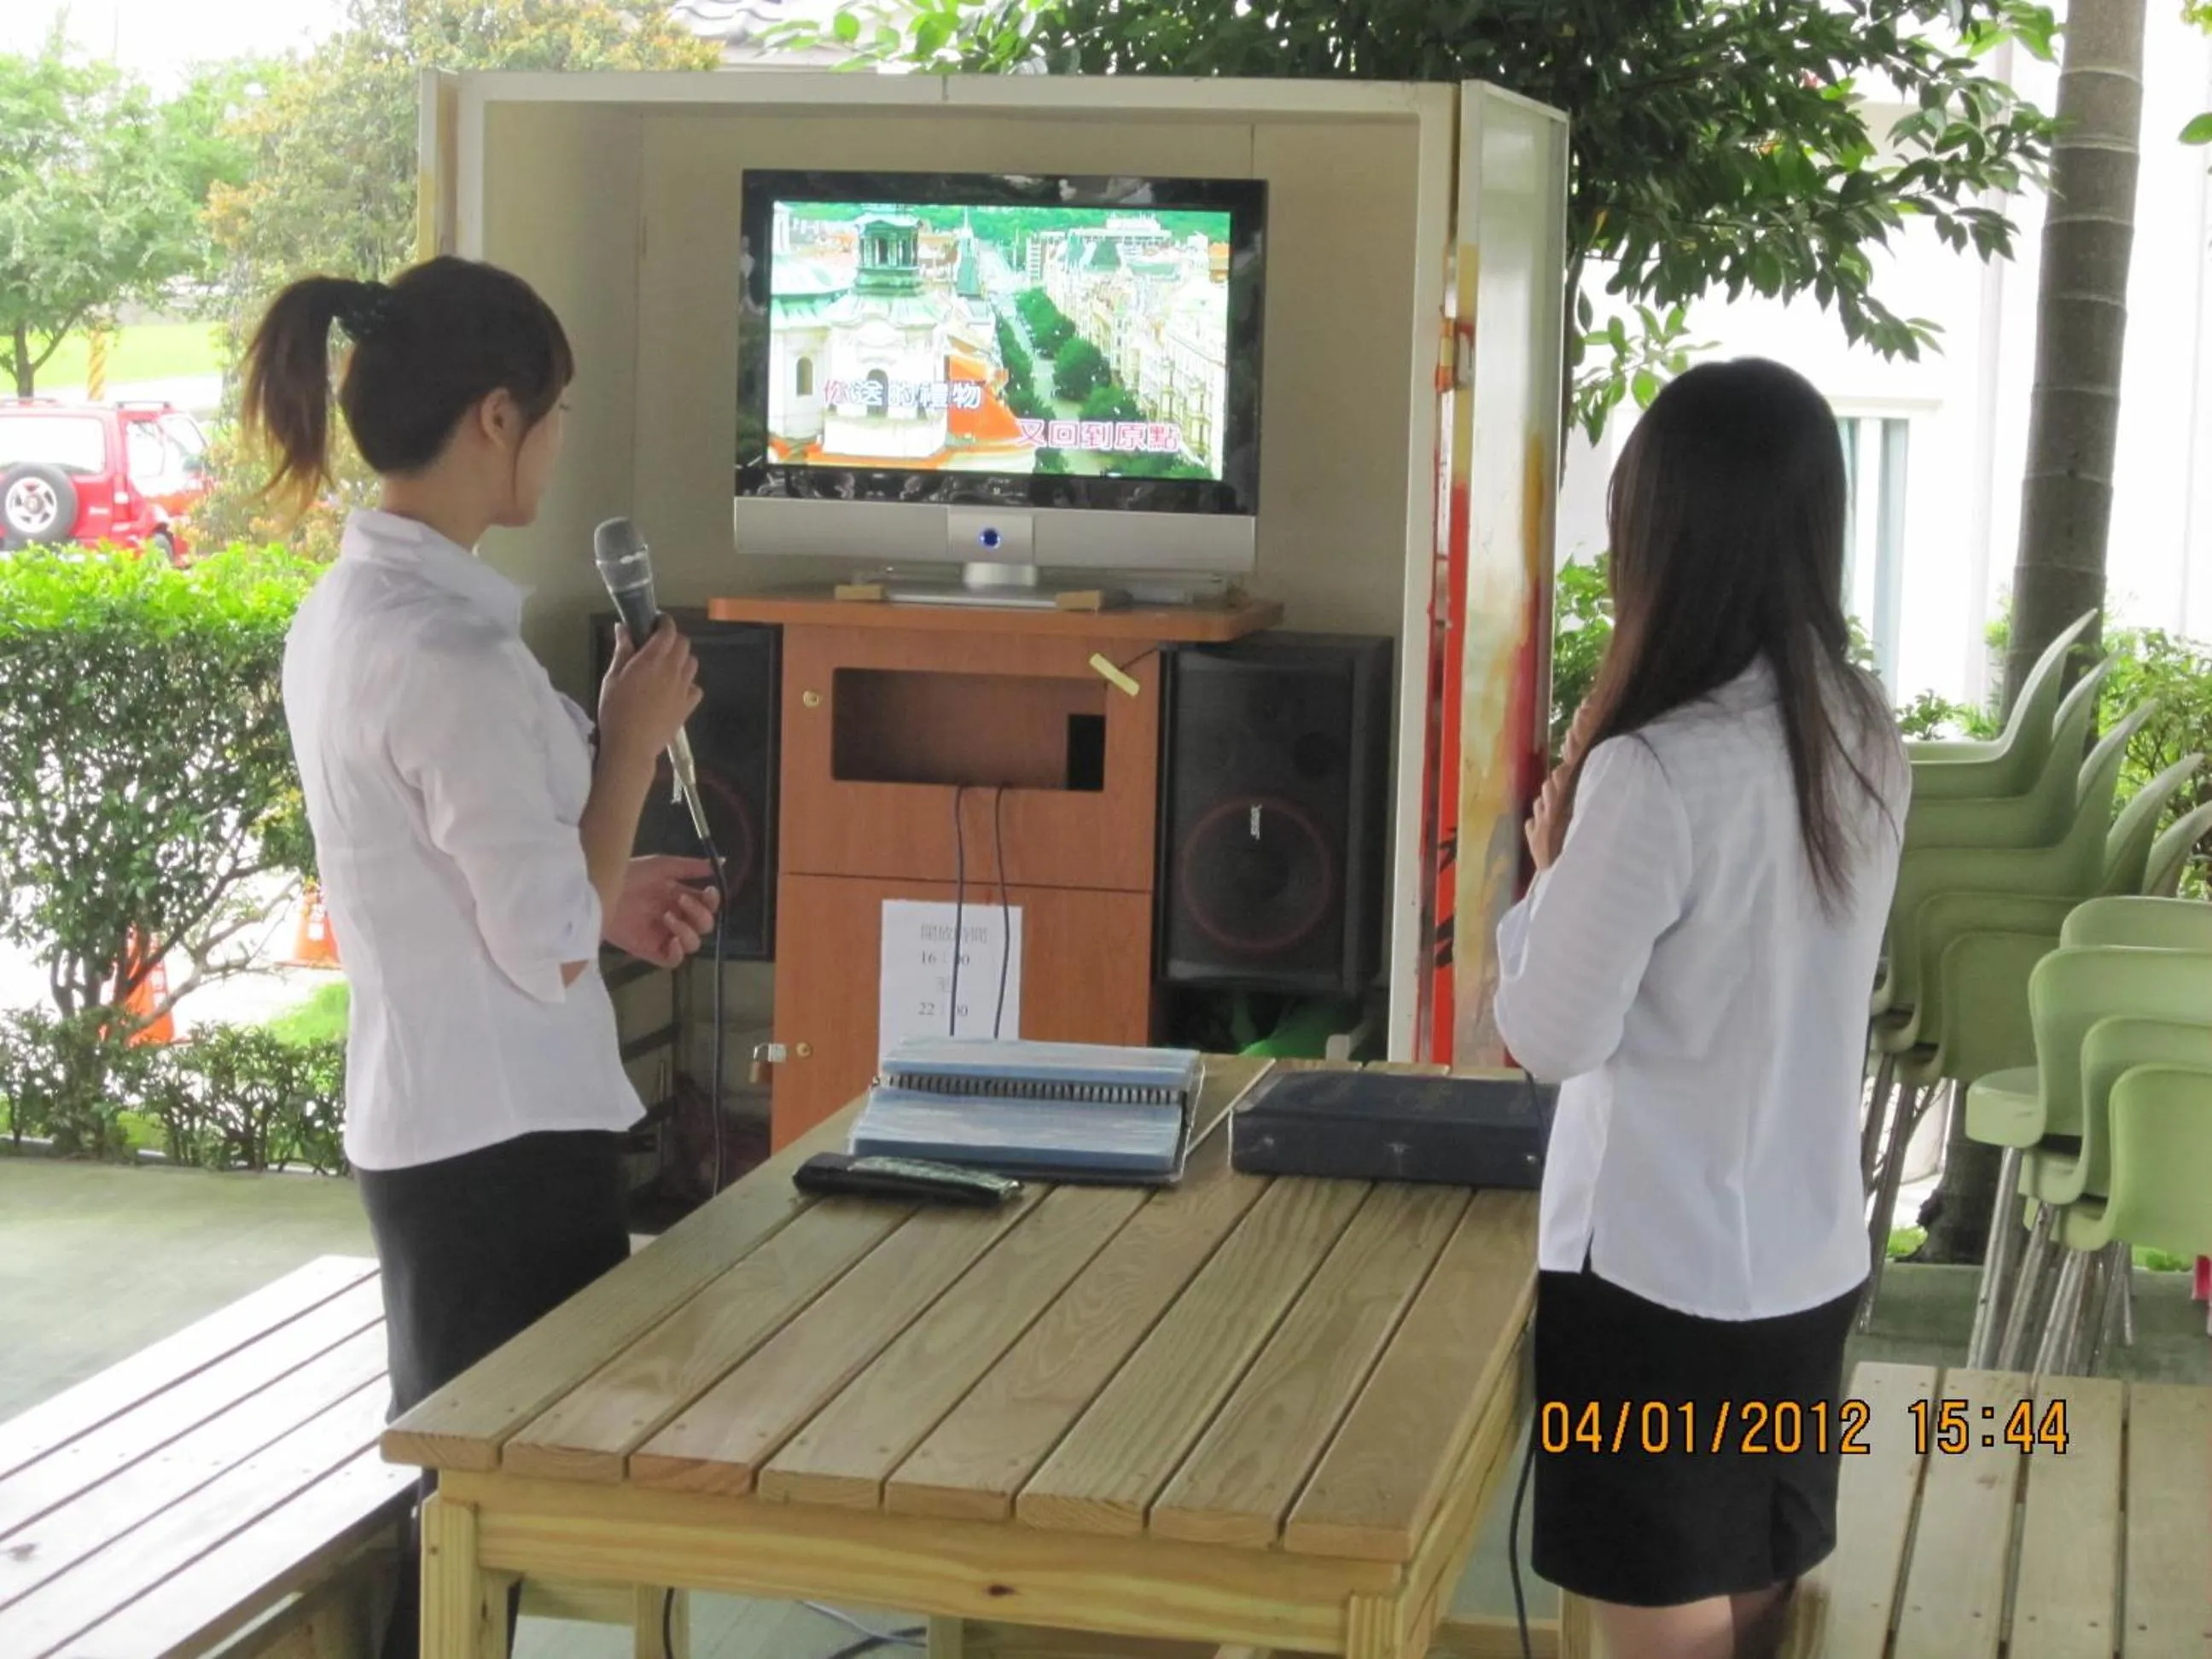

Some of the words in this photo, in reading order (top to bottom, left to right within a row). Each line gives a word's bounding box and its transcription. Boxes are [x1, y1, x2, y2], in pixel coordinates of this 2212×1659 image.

[1016, 418, 1182, 452] 又回到原點
